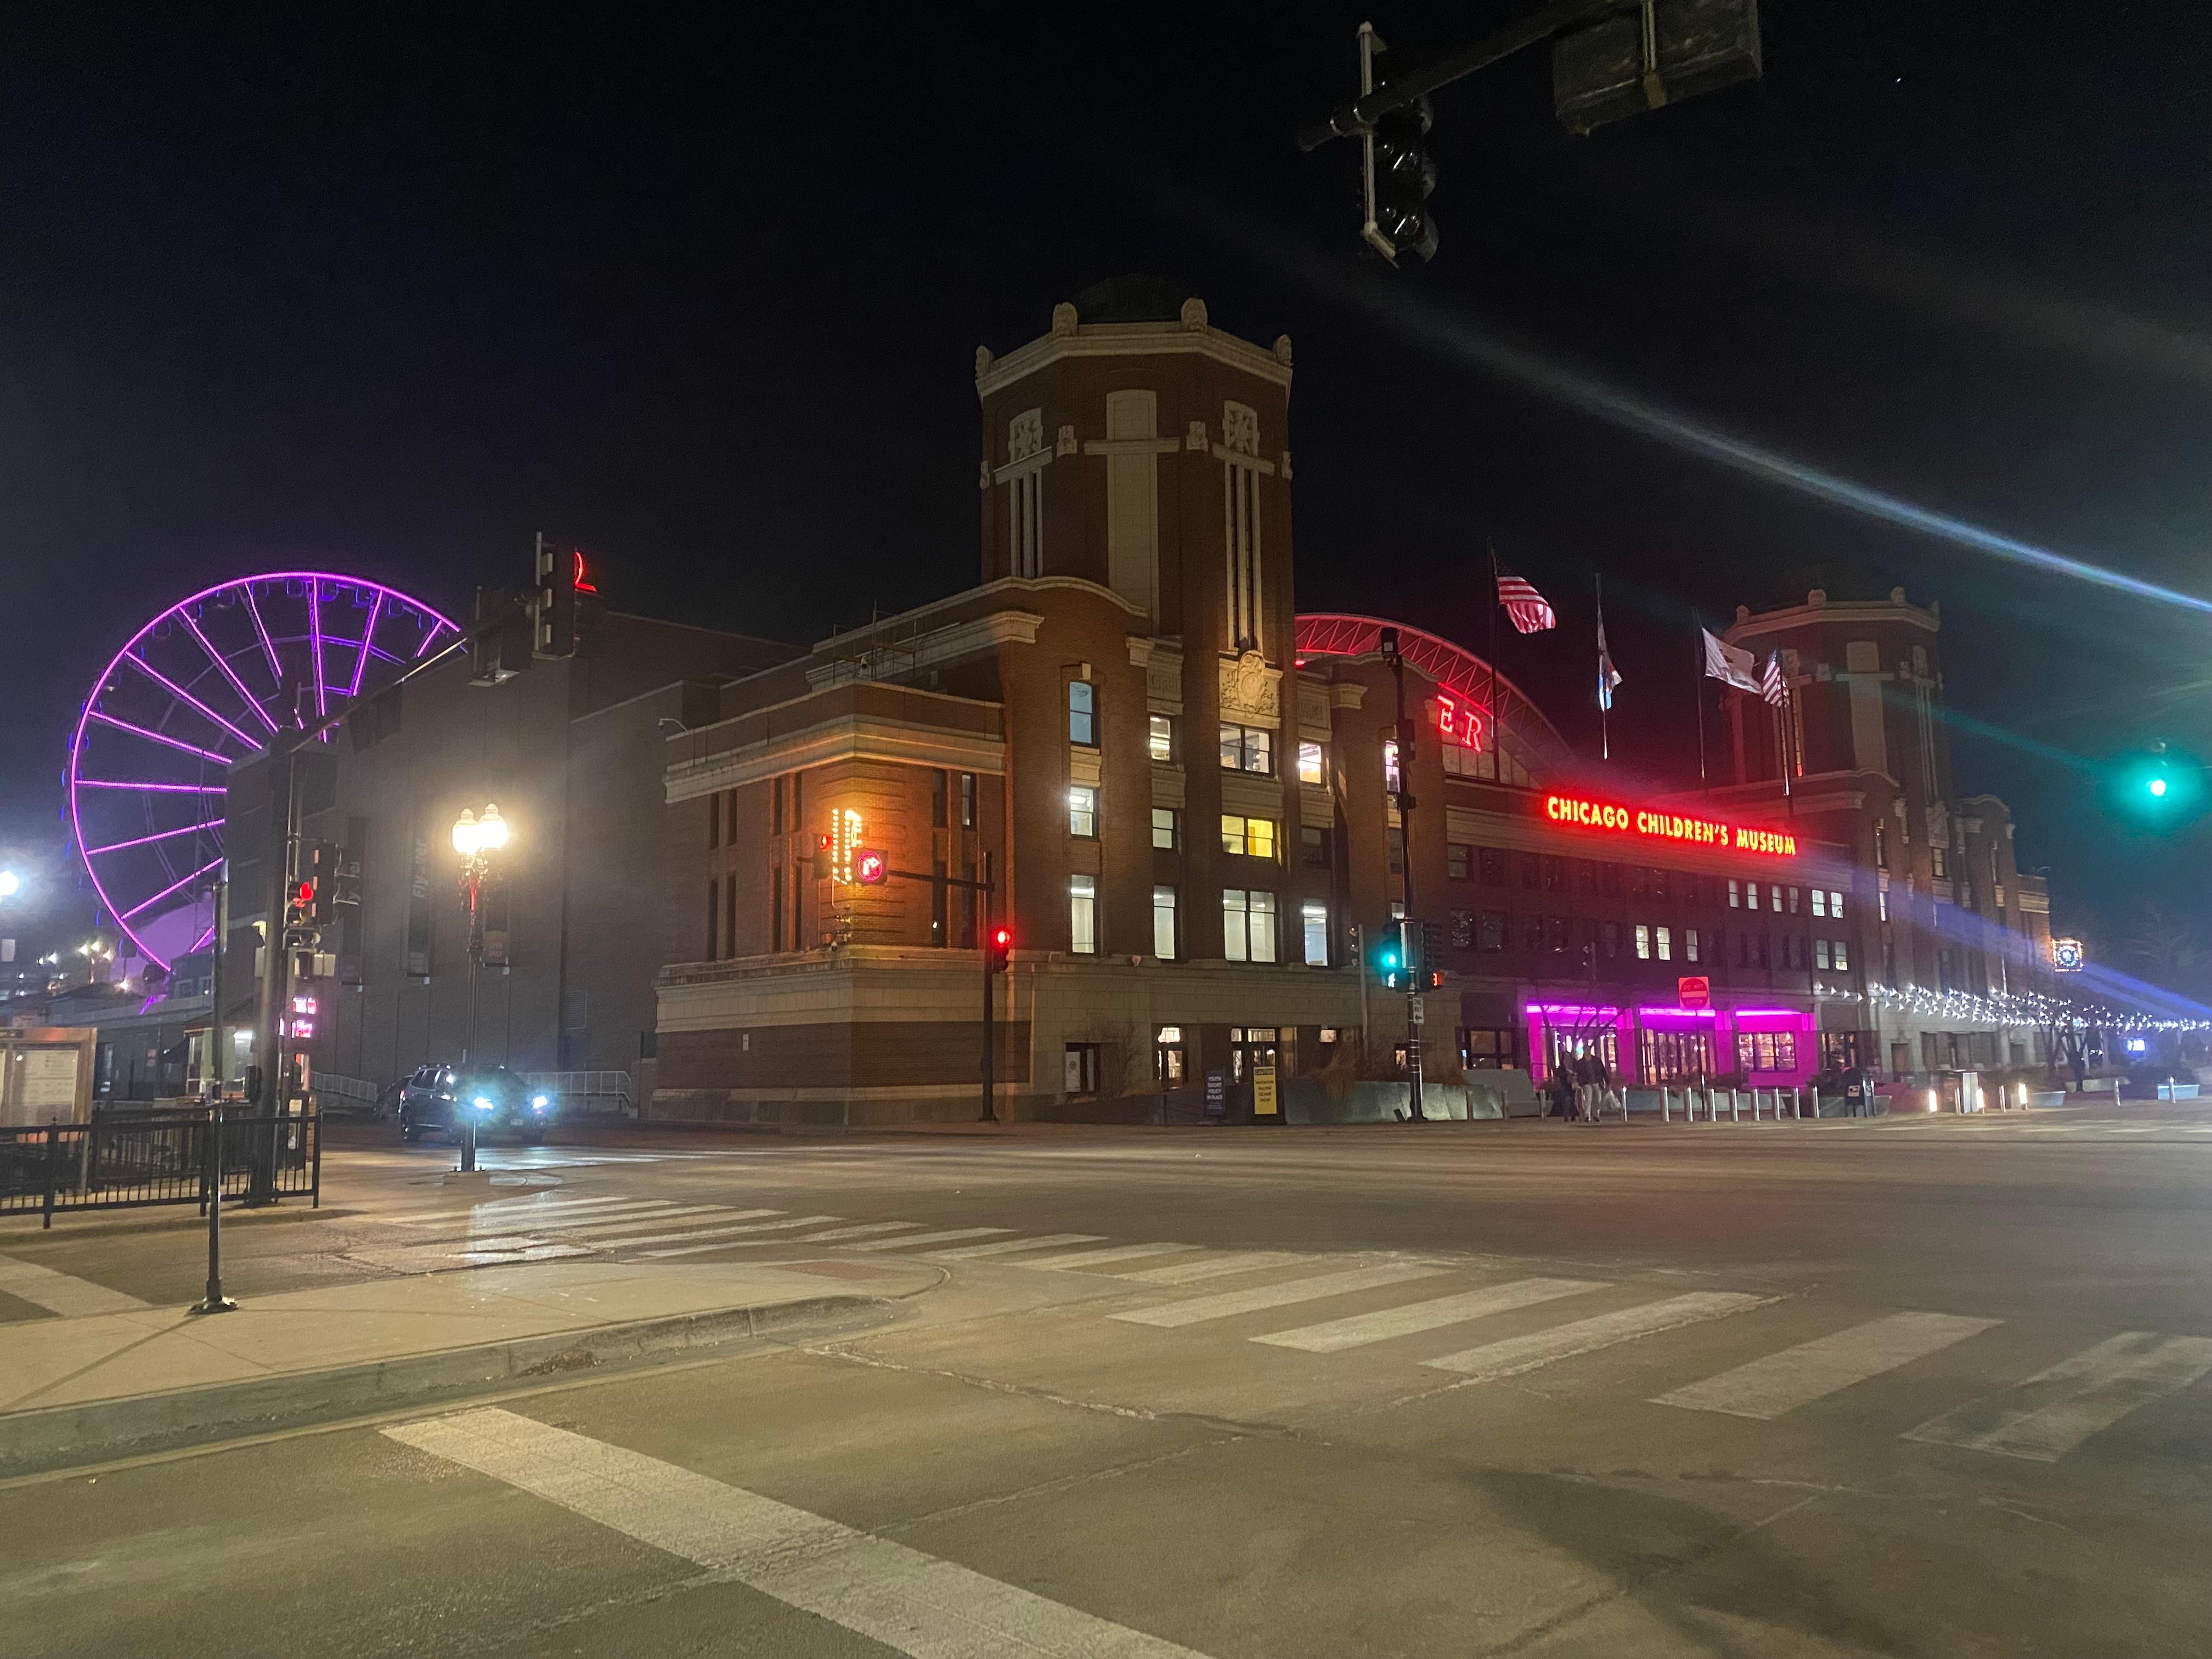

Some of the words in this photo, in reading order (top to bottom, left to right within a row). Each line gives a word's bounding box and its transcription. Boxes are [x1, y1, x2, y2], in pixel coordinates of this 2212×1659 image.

[1548, 796, 1629, 830] CHICAGO
[1638, 812, 1728, 845] CHILDREN'S
[1736, 829, 1796, 855] MUSEUM
